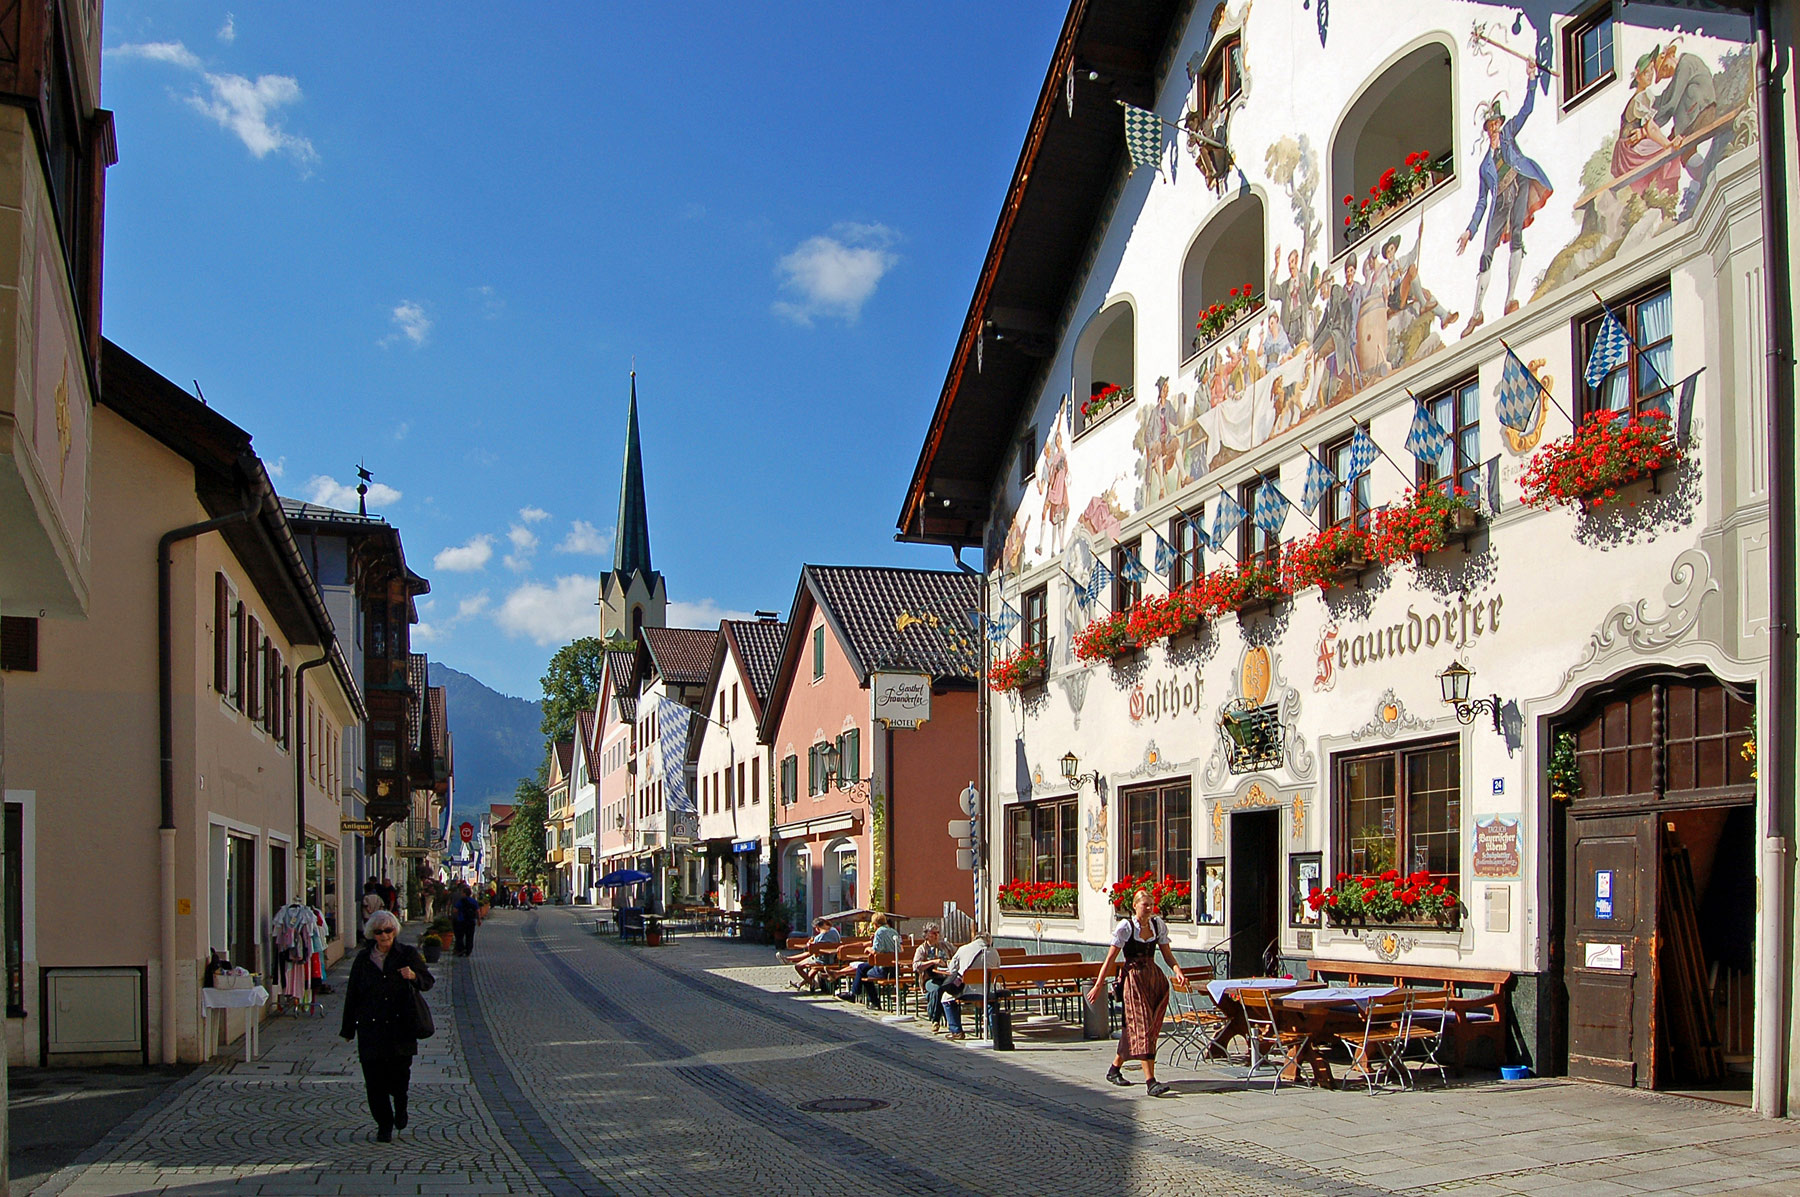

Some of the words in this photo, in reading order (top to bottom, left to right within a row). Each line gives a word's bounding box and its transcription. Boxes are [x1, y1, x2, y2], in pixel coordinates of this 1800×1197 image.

[1129, 668, 1204, 723] Gasthof
[1313, 594, 1503, 690] Fraundorfer
[1494, 780, 1502, 790] 24
